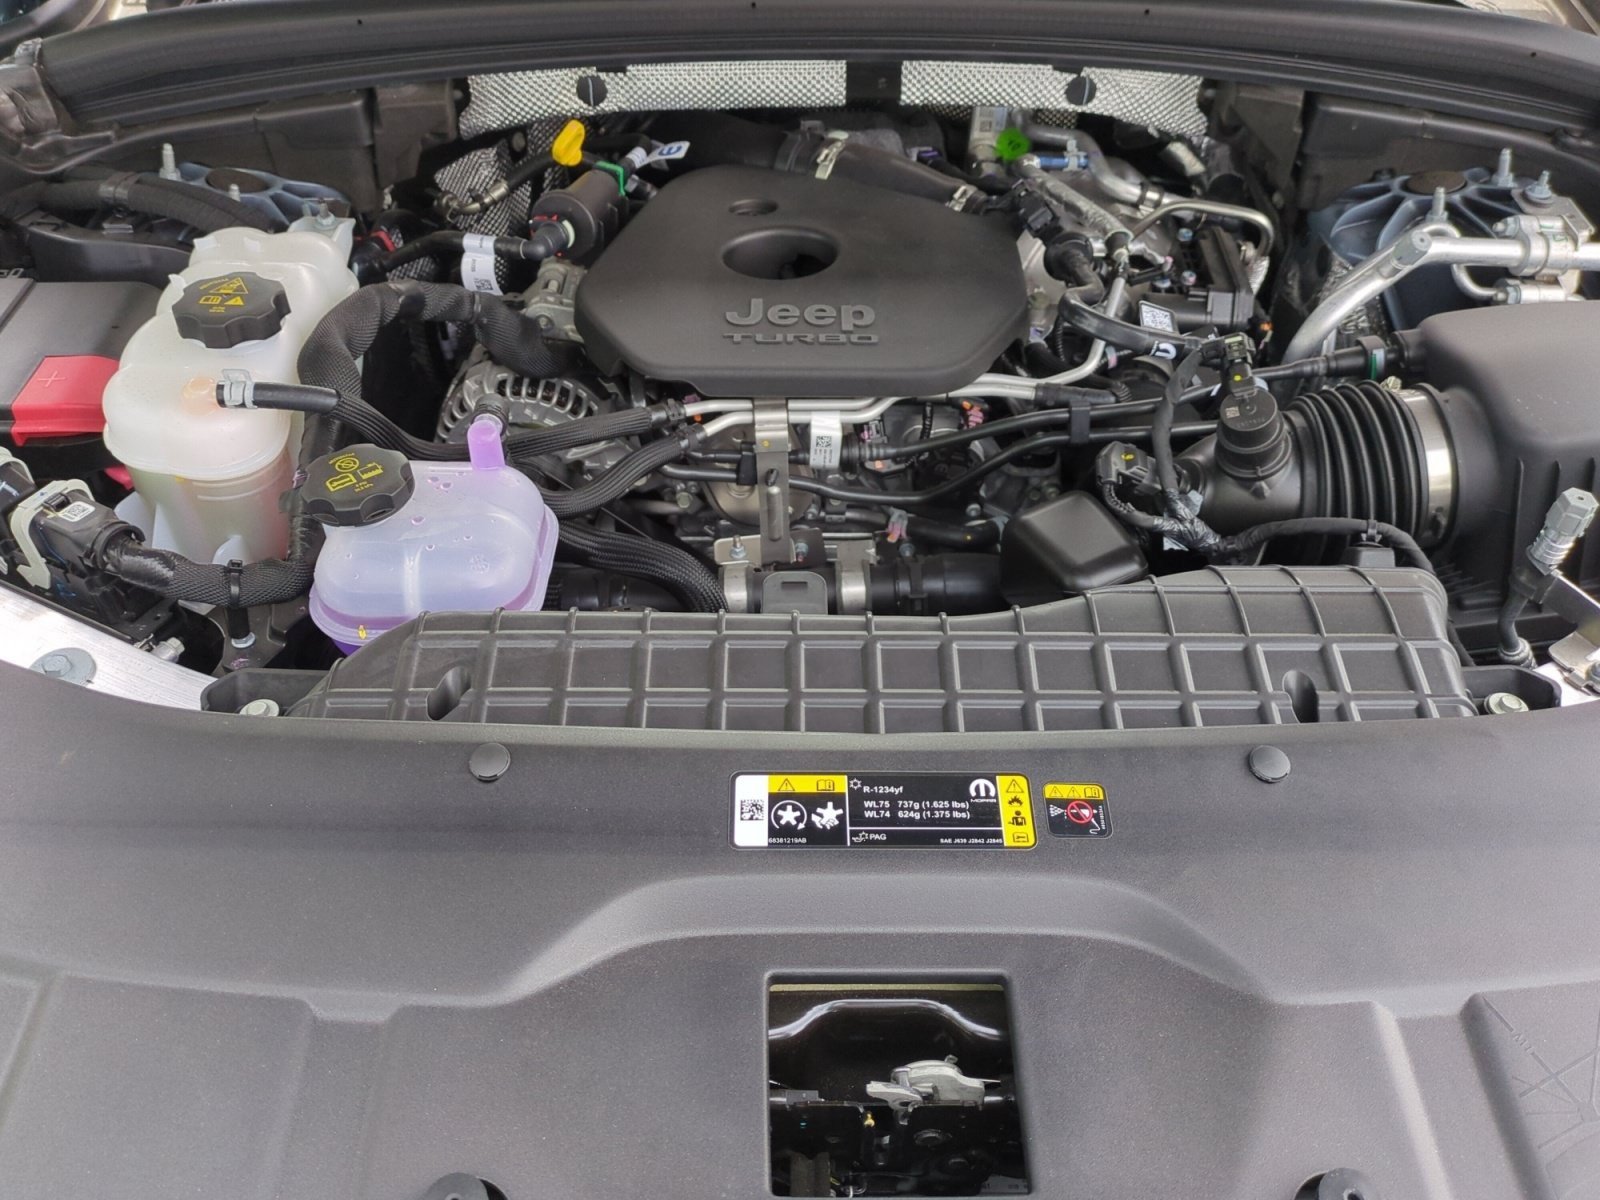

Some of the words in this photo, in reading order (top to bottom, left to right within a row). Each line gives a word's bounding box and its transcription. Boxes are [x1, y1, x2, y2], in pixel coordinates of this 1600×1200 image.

[725, 298, 876, 333] Jeep
[723, 333, 880, 345] TURBO
[863, 786, 904, 795] R-1234yf
[863, 800, 890, 808] WL75
[897, 801, 920, 809] 737g
[921, 800, 950, 809] (1.625
[951, 800, 970, 809] lbs)
[864, 810, 891, 818] WL74
[897, 810, 921, 819] 624g
[922, 810, 951, 819] (1.375
[952, 810, 971, 819] lbs)
